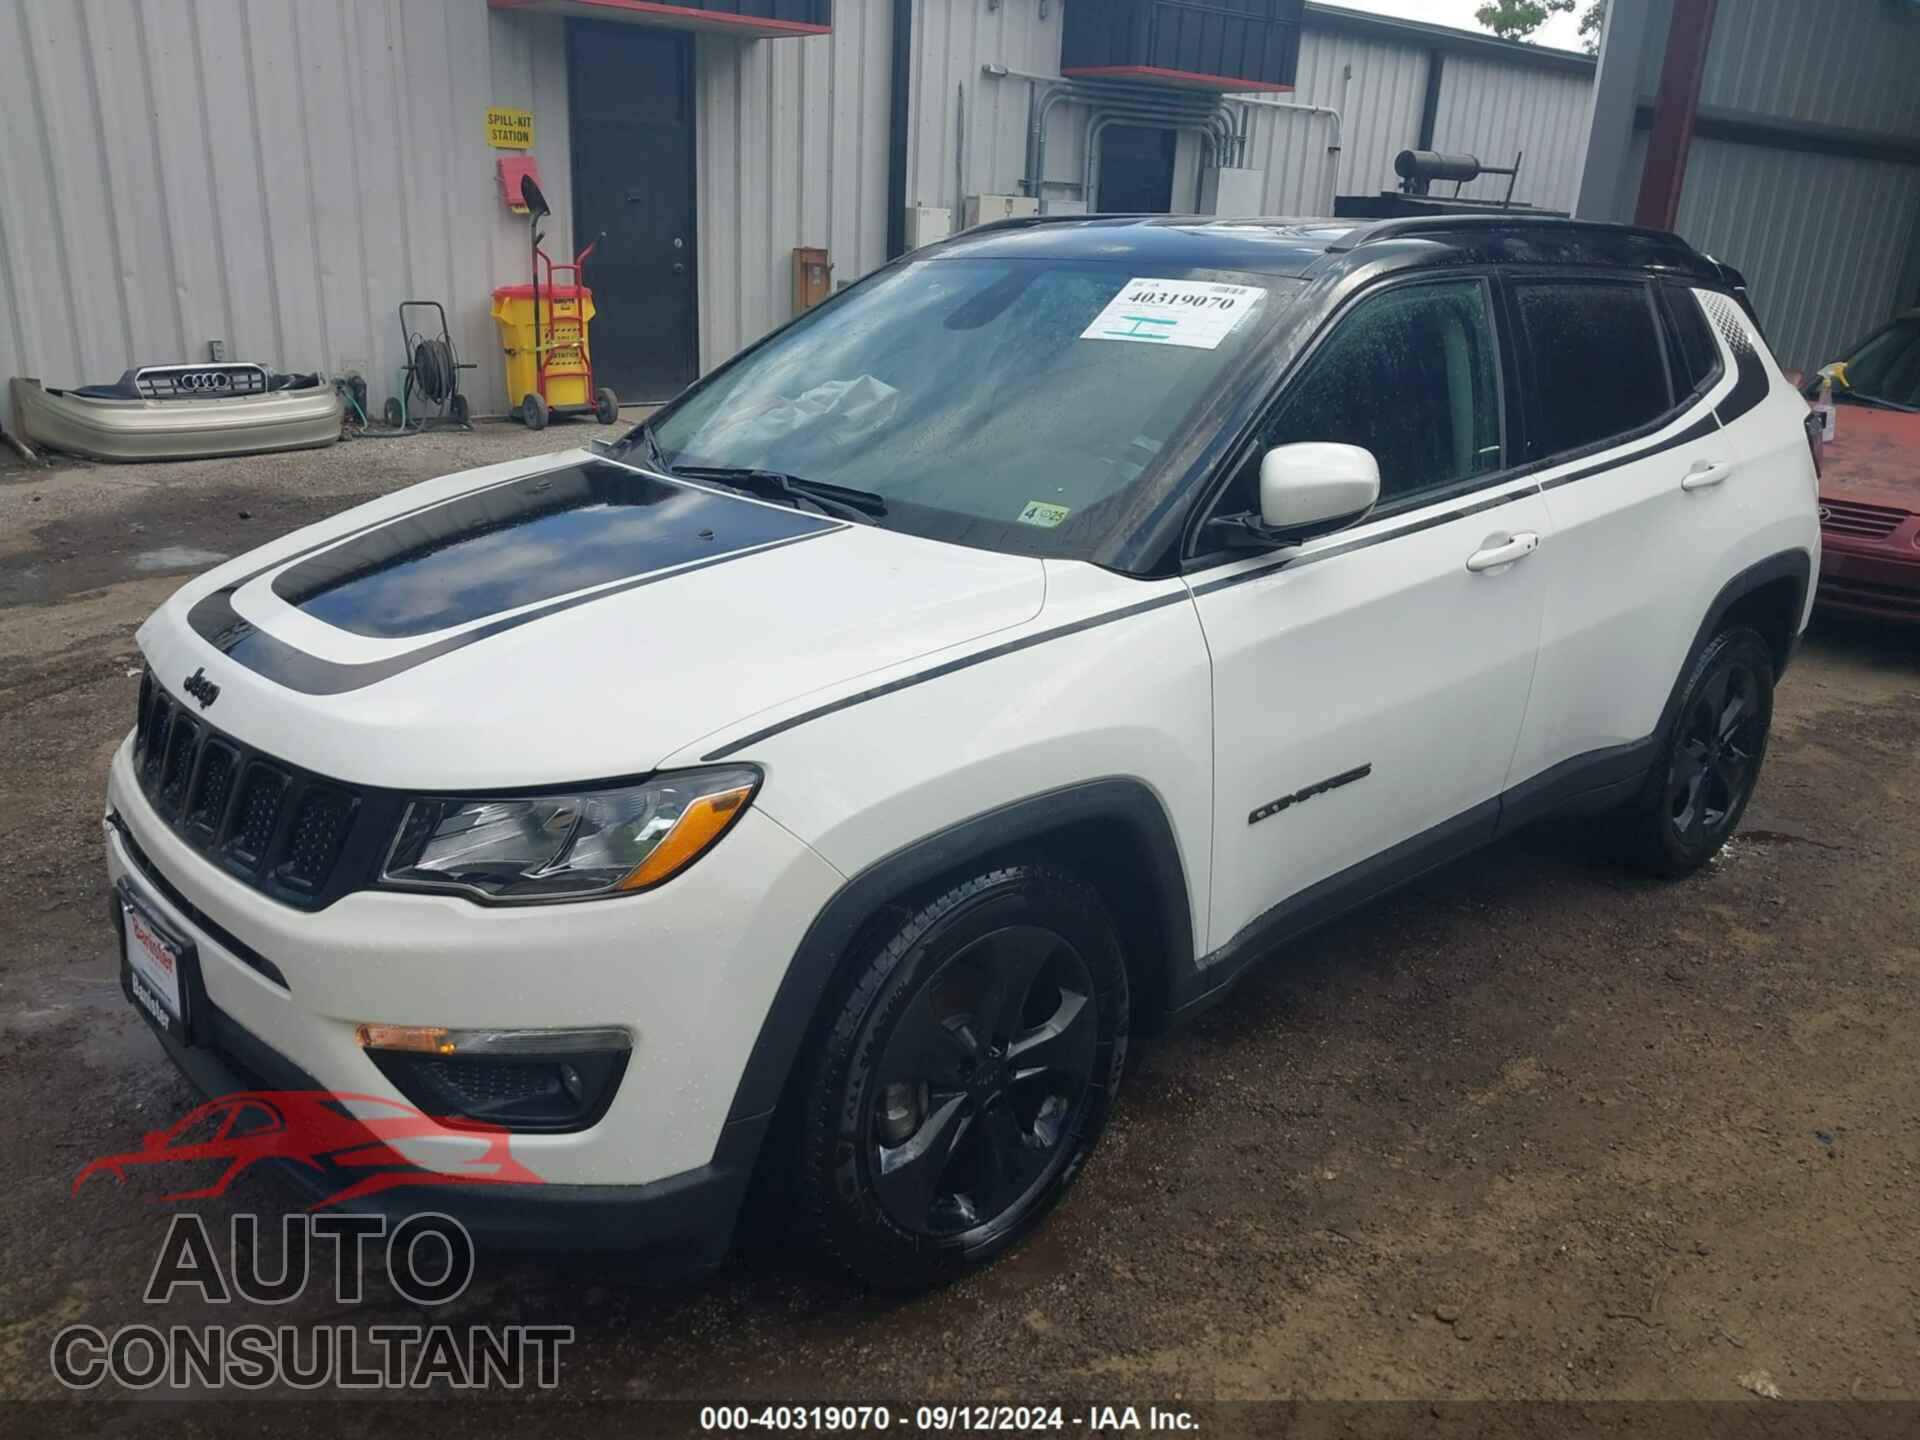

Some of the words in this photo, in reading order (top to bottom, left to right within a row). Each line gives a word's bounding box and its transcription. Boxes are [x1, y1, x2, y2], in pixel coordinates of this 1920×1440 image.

[491, 129, 529, 142] STATION
[1128, 291, 1236, 310] 40319070
[1024, 507, 1038, 520] 4
